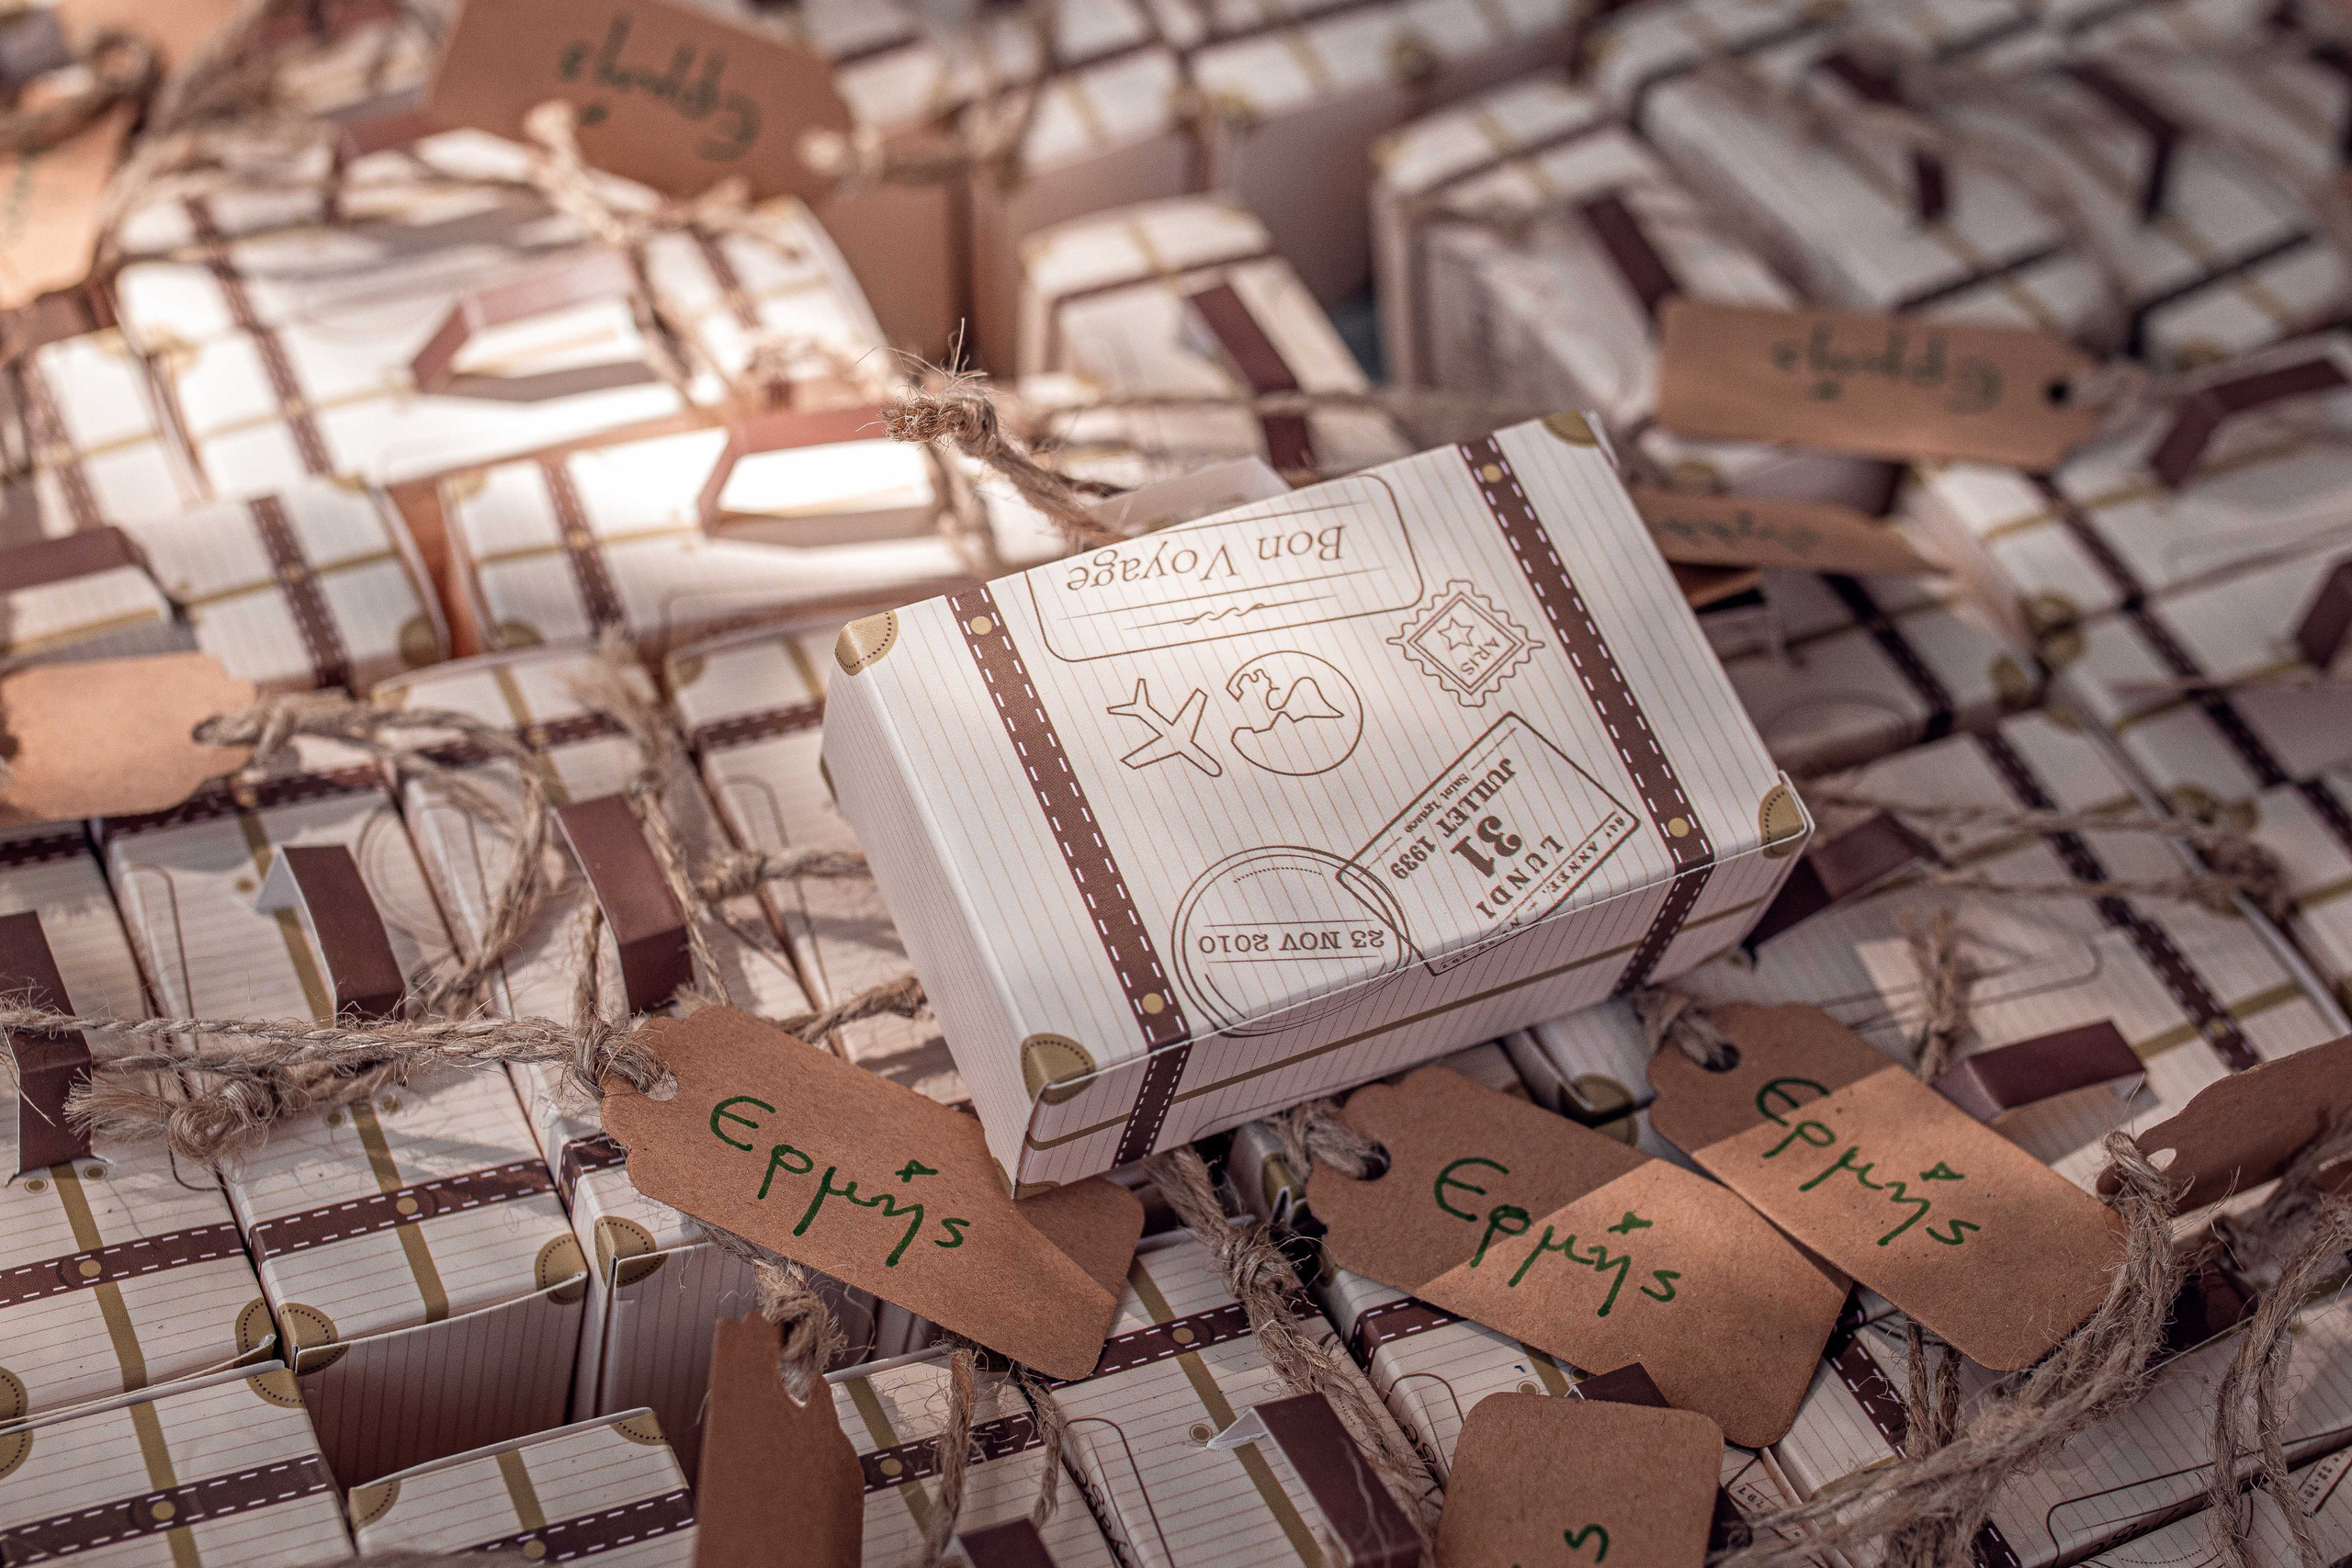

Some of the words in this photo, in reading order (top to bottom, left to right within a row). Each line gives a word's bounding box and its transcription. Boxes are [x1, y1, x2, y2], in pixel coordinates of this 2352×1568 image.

[1257, 525, 1347, 562] Bon
[1067, 540, 1240, 591] Voyage
[1461, 637, 1500, 675] ARIS
[1435, 758, 1517, 839] JUILLET
[1390, 835, 1437, 880] 1939
[1450, 815, 1523, 879] 31
[1476, 835, 1565, 919] LUNDI
[1199, 933, 1269, 953] 2010
[1279, 931, 1341, 952] NOV
[1351, 930, 1385, 949] 23
